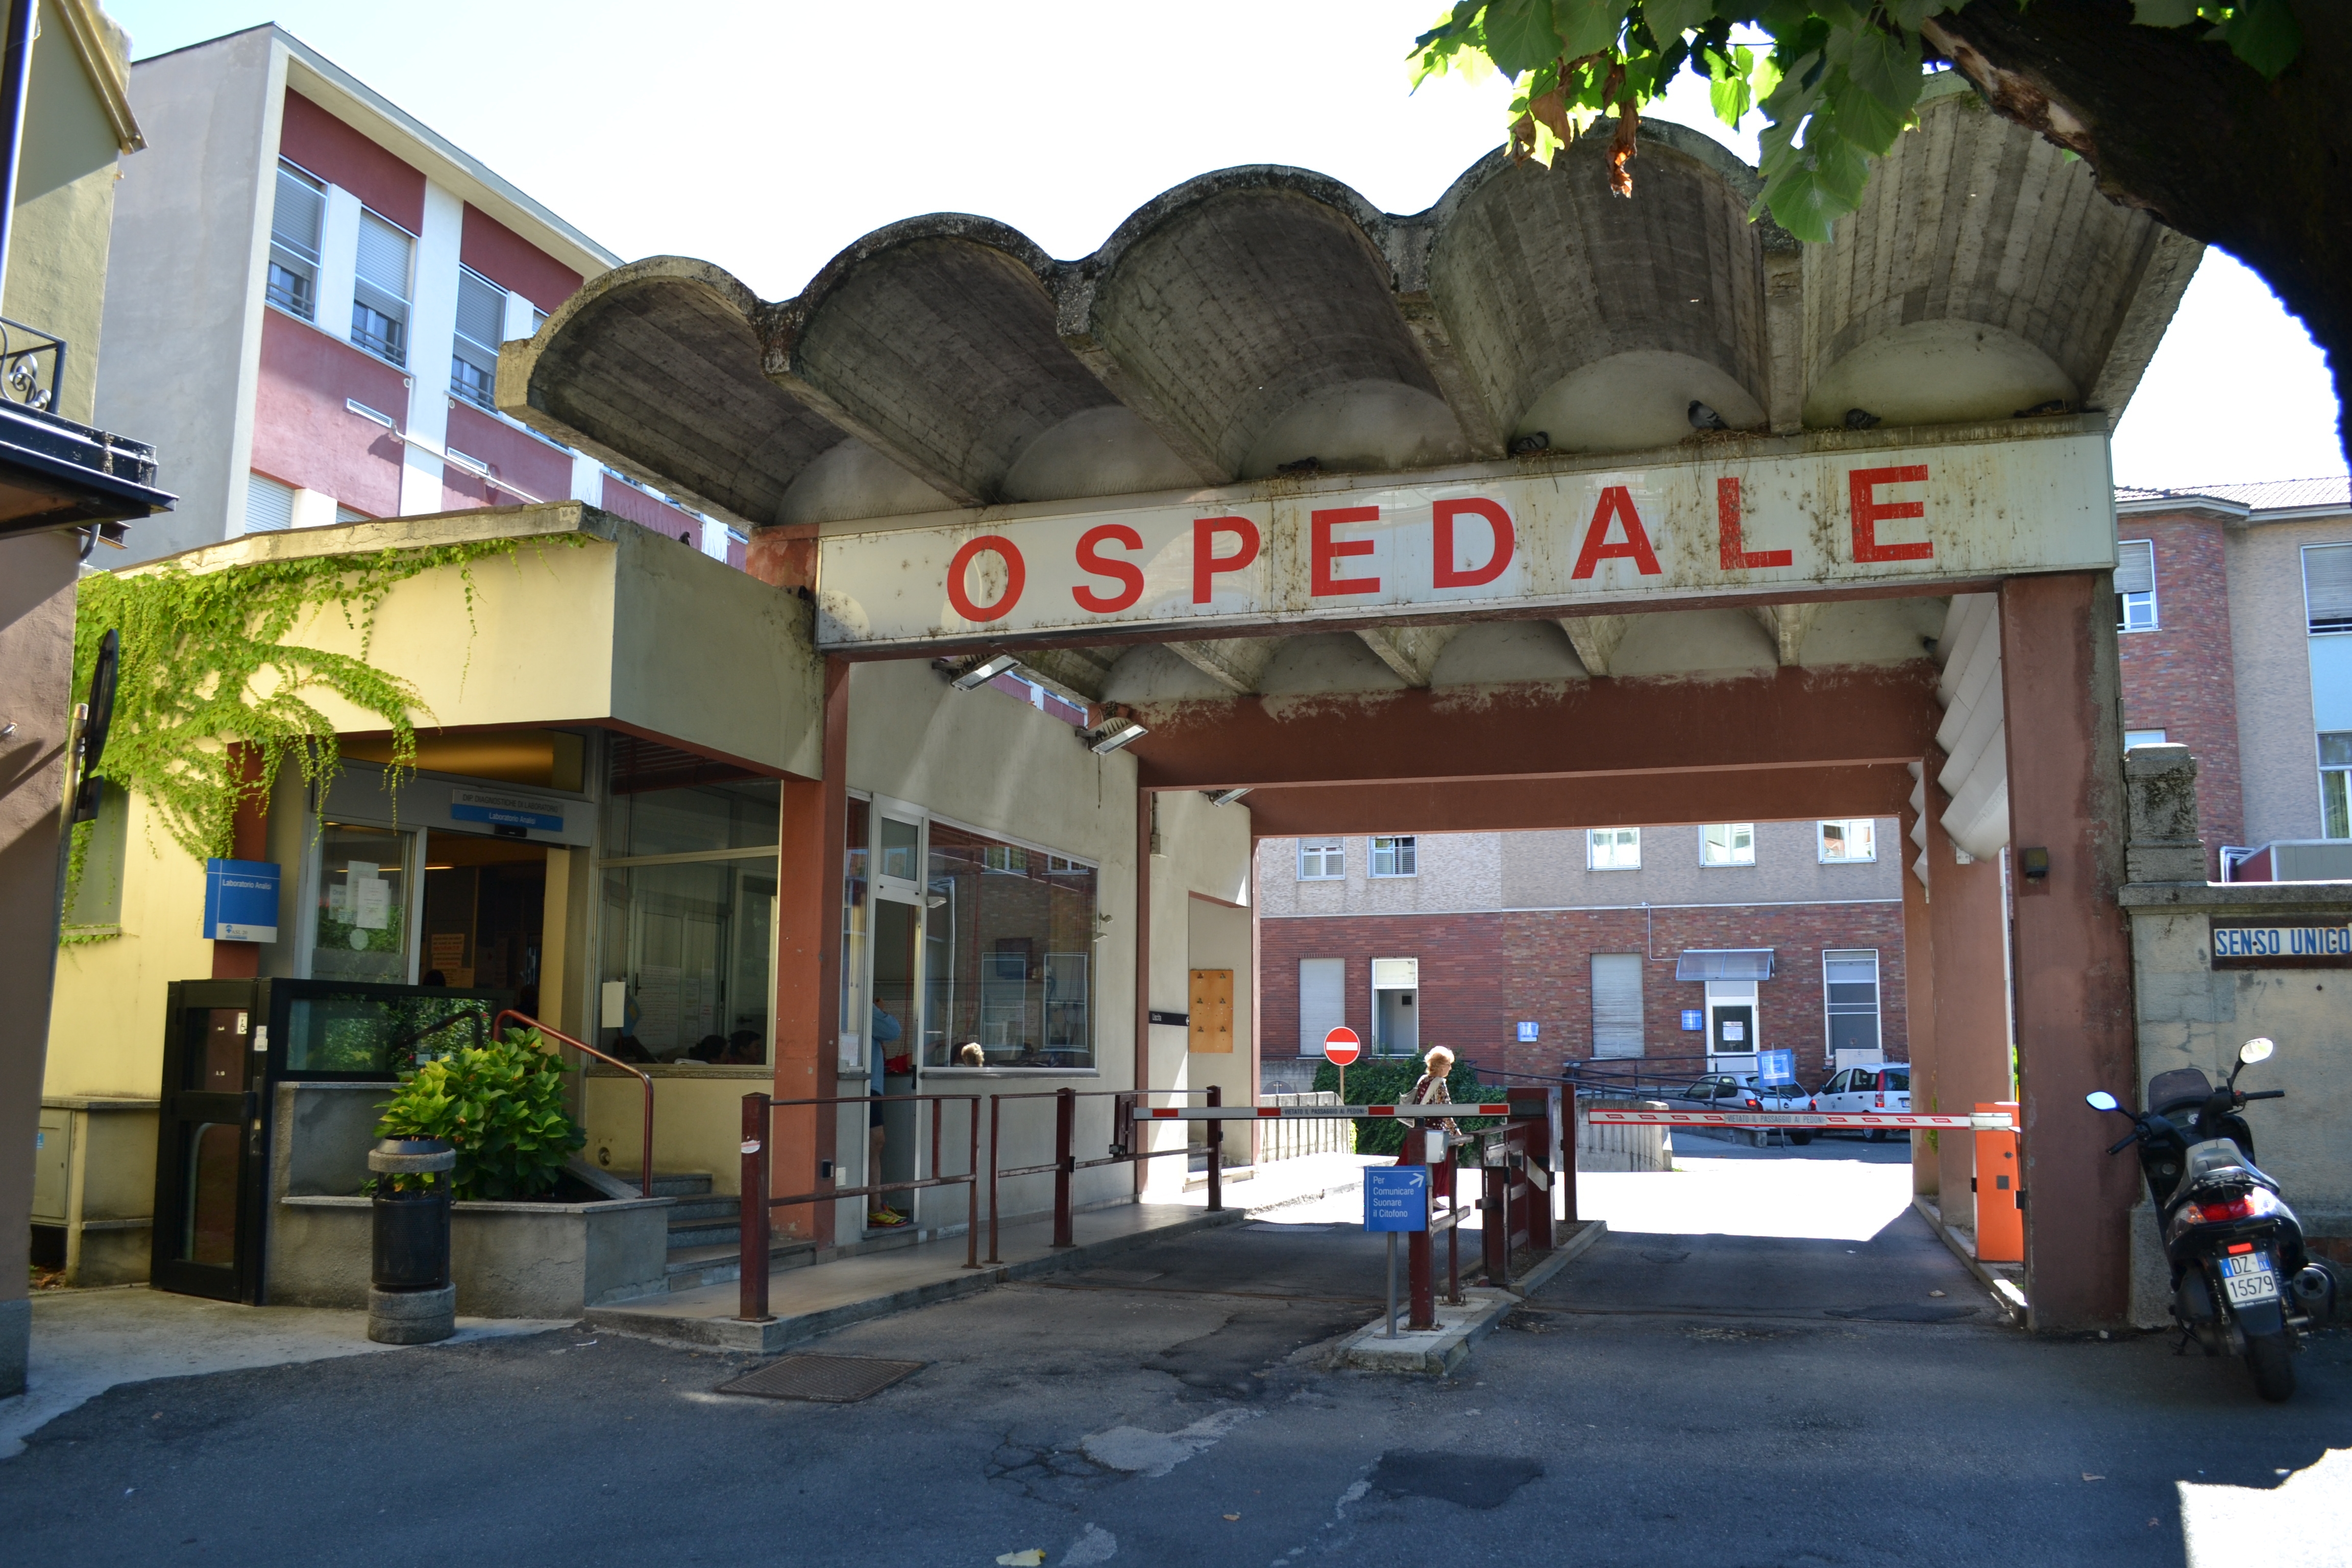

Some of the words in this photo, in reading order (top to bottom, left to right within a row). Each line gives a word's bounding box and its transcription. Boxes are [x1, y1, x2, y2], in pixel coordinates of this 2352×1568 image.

[948, 464, 1934, 623] OSPEDALE
[475, 796, 516, 807] DIAGNOSTICHE
[524, 802, 558, 813] LABORATORIO
[489, 813, 519, 822] Laboratorio
[520, 816, 536, 824] Analisi
[223, 879, 254, 889] Laboratorio
[255, 882, 272, 890] Analisi
[2216, 929, 2280, 955] SENSO
[2291, 928, 2350, 954] UNICO
[1373, 1176, 1385, 1184] Per
[1373, 1187, 1414, 1195] Comunicare
[1373, 1198, 1402, 1206] Suonare
[1379, 1209, 1408, 1217] Citofono
[2231, 1256, 2251, 1275] DZ
[2259, 1261, 2270, 1270] AL
[2230, 1275, 2274, 1298] 15579
